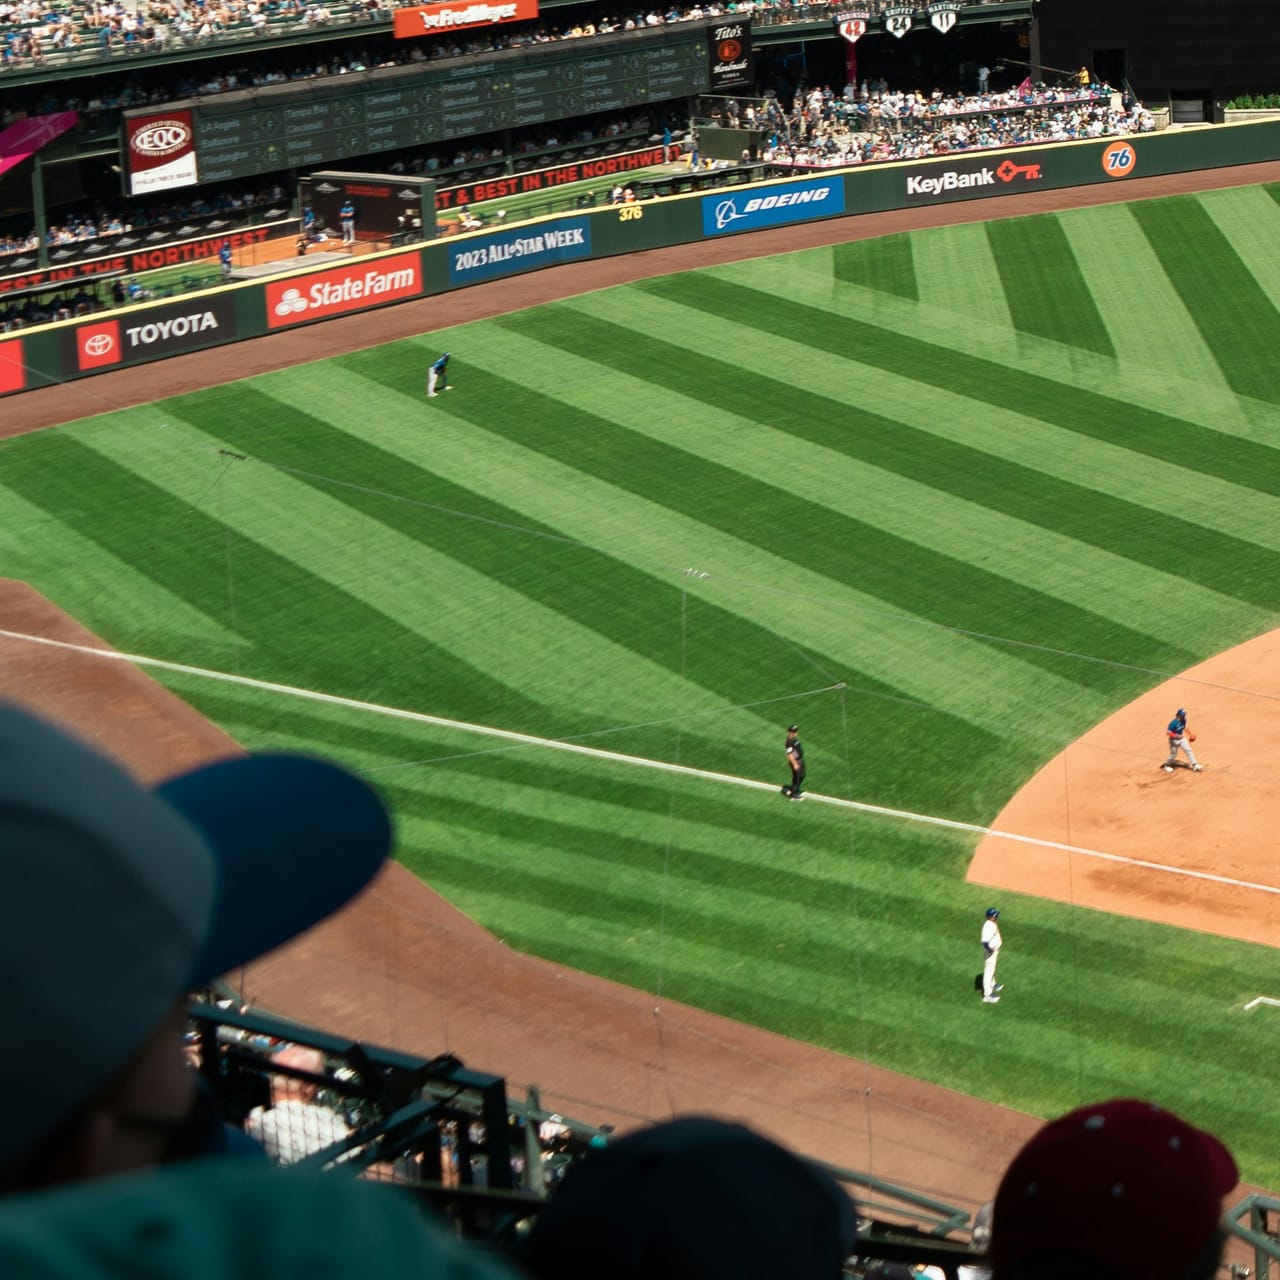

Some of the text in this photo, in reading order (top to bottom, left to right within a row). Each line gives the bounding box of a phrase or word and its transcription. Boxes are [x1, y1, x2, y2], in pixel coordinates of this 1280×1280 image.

[845, 21, 861, 36] 42
[892, 18, 907, 31] 24
[142, 128, 181, 148] EQC
[1108, 148, 1132, 171] 76
[474, 167, 578, 201] BEST IN THE
[906, 166, 995, 195] KeyBank
[744, 186, 831, 212] BOEING
[619, 205, 644, 222] 376
[455, 249, 489, 271] 2023
[545, 228, 585, 251] WEEK
[126, 311, 219, 347] TOYOTA
